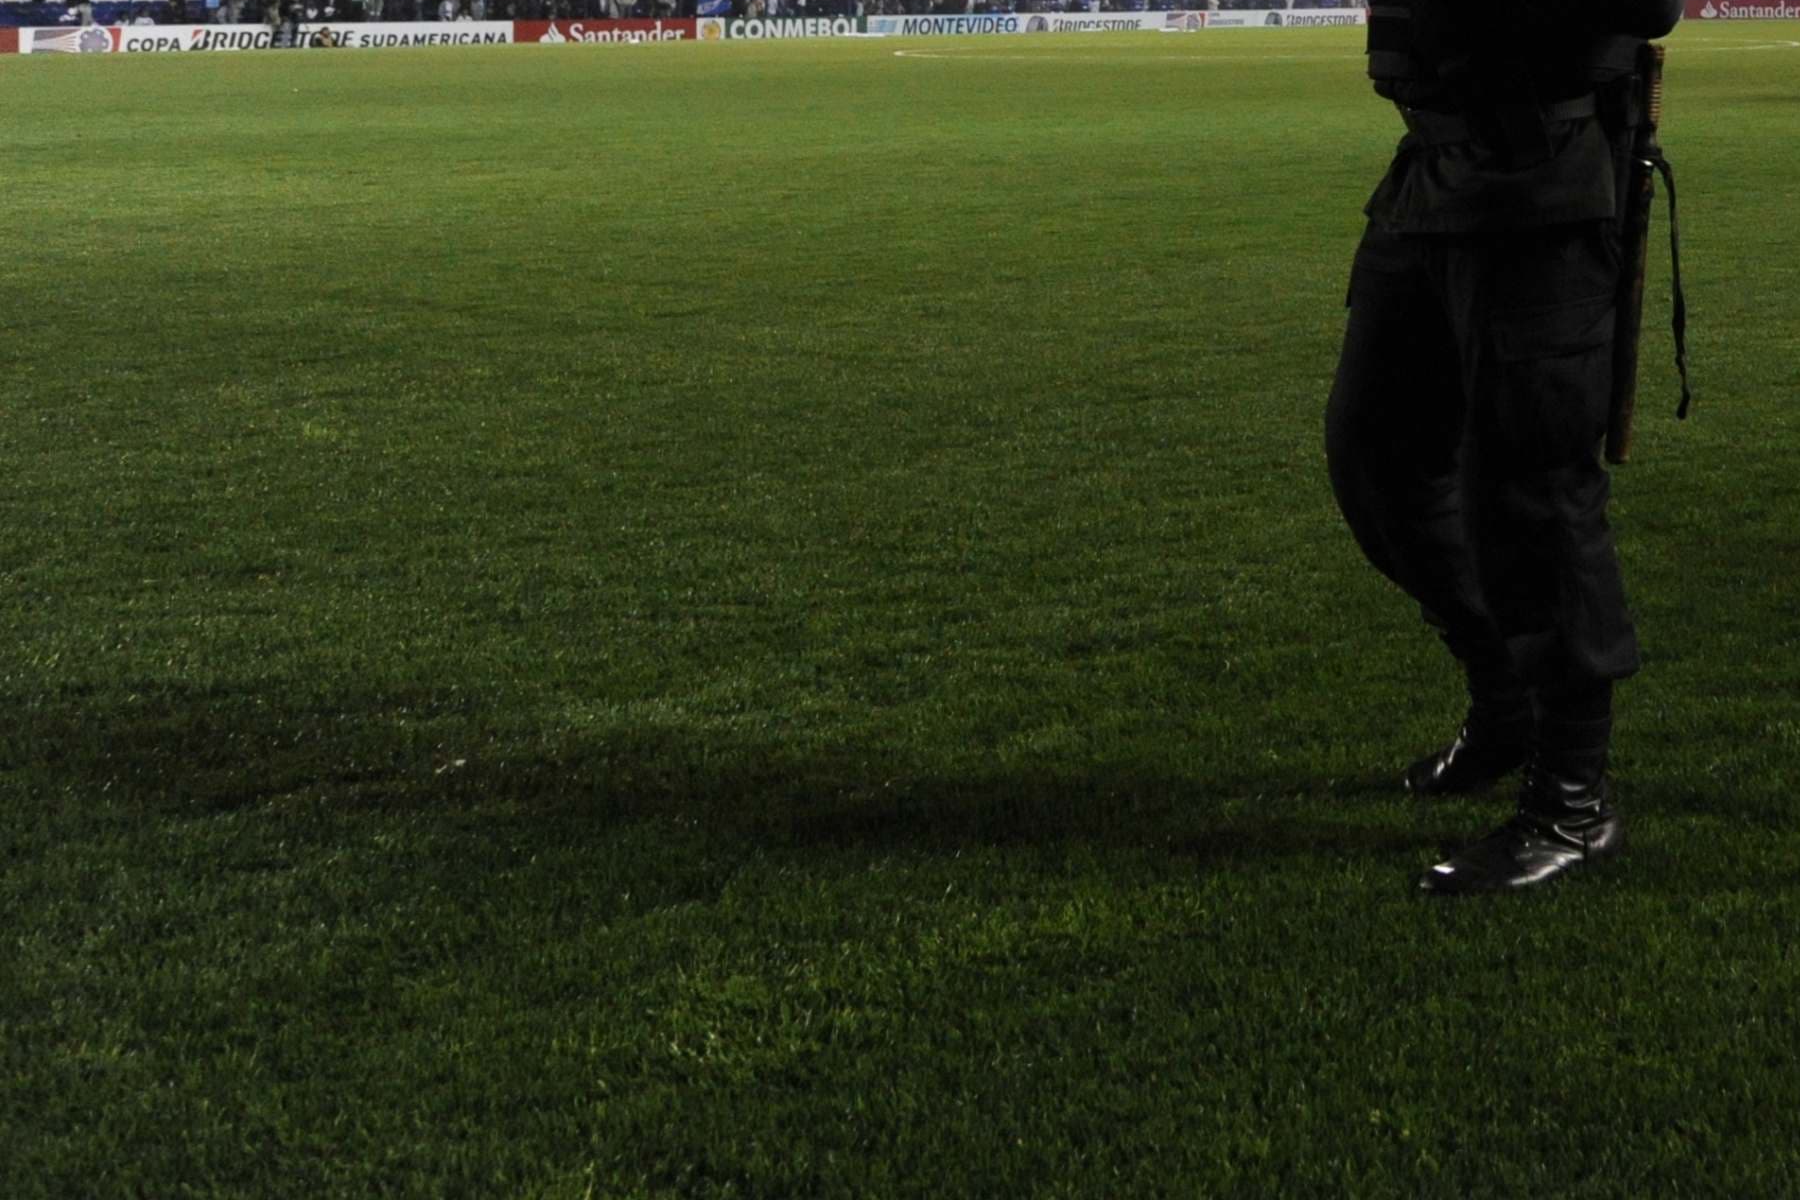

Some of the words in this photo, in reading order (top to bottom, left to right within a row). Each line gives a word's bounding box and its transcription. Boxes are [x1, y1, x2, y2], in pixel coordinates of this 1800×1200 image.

[569, 21, 686, 43] Santander
[729, 17, 860, 39] CONMEBOL
[902, 16, 1018, 35] MONTEVIDEO
[127, 38, 182, 52] COPA
[360, 31, 507, 48] SUDAMERICANA
